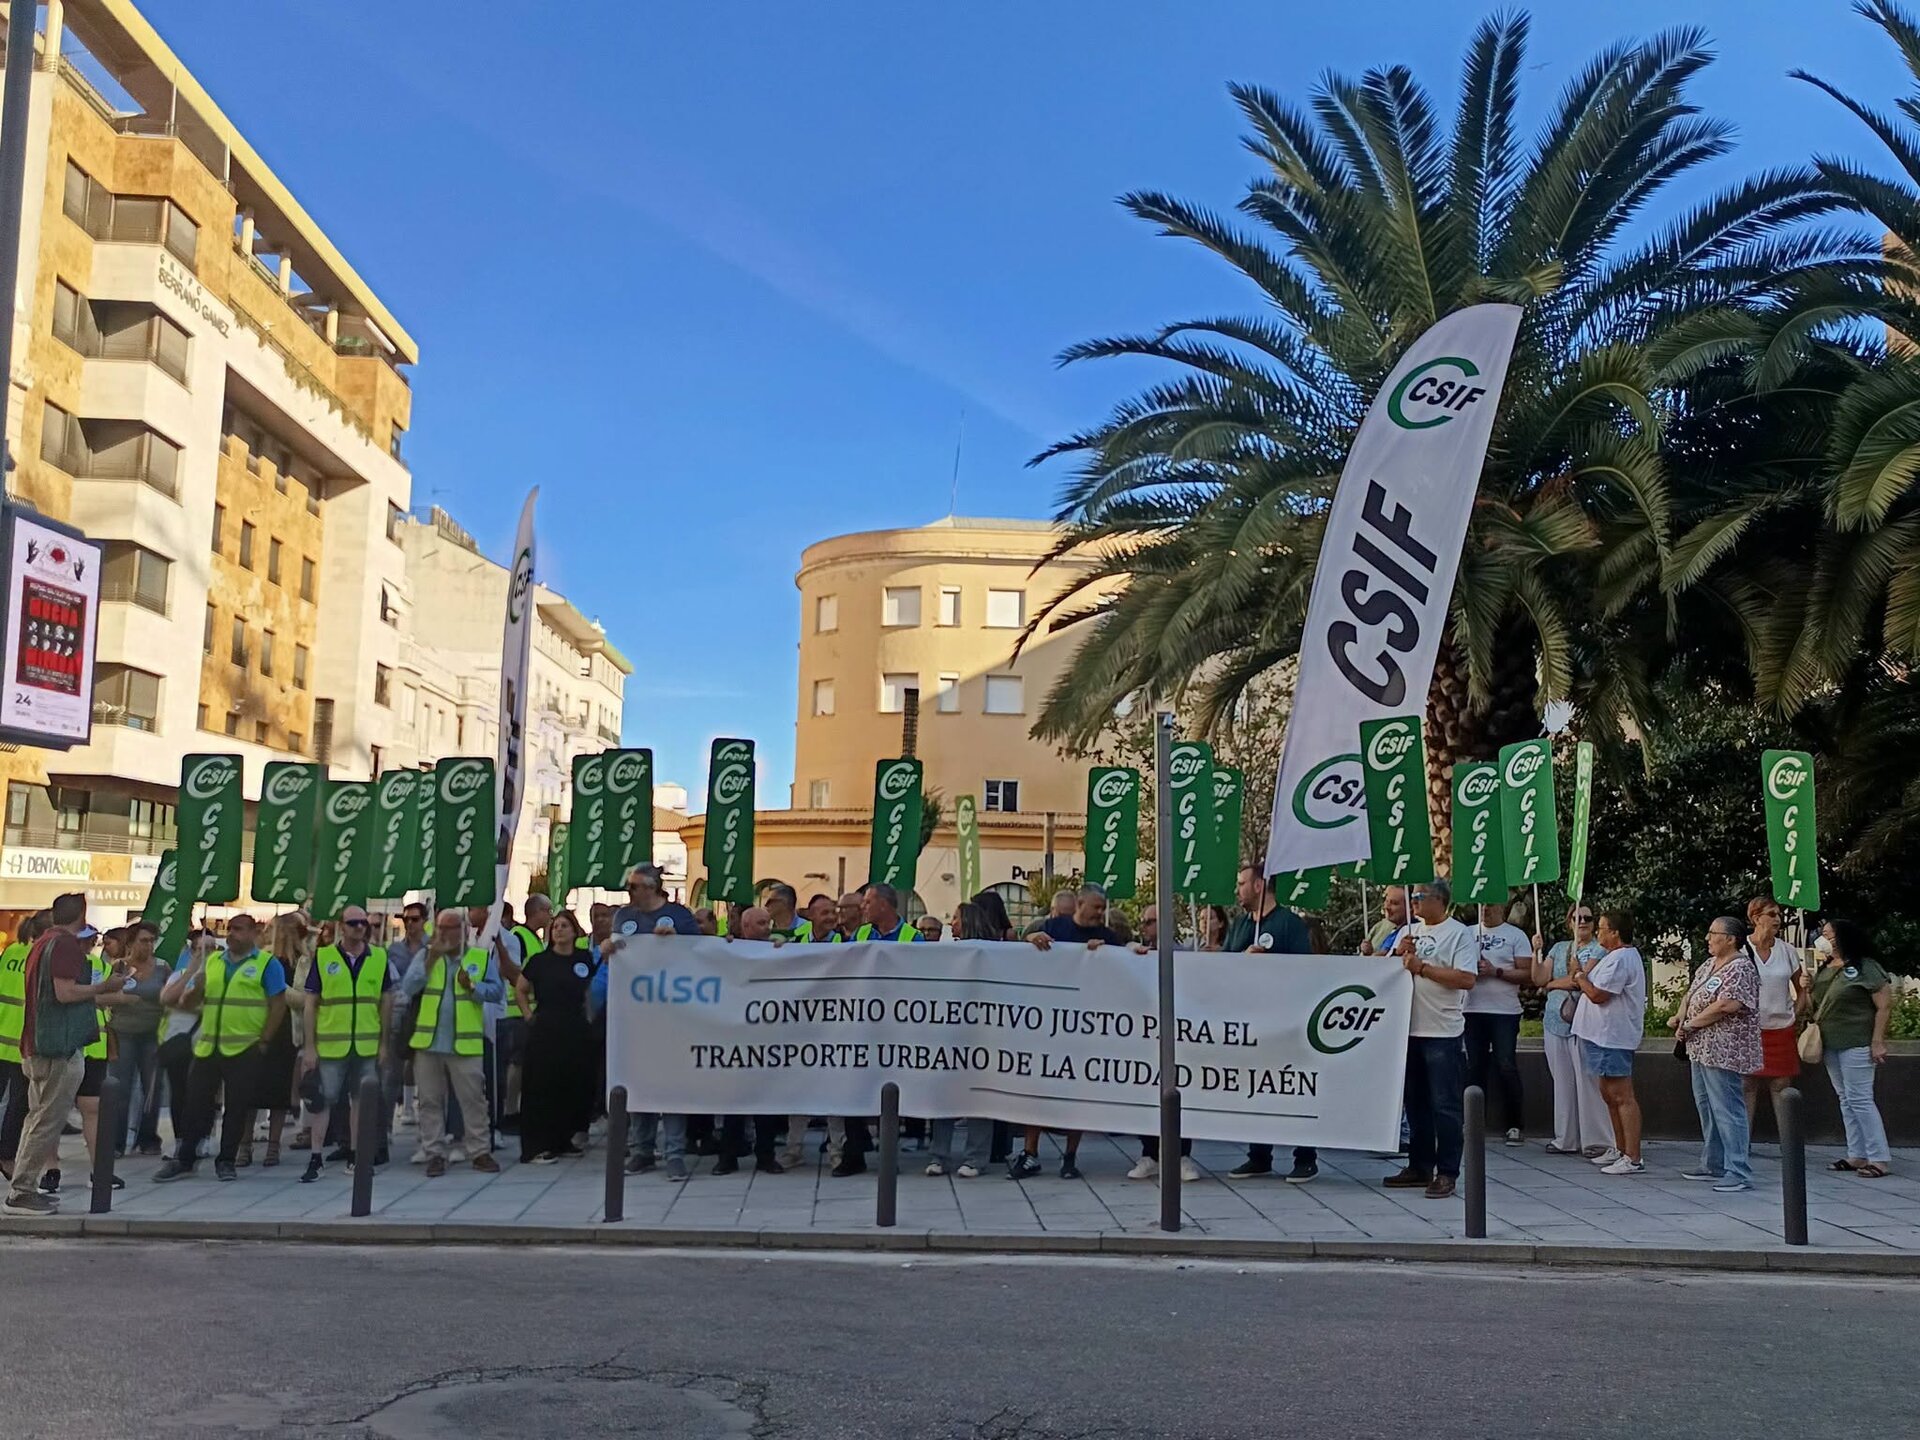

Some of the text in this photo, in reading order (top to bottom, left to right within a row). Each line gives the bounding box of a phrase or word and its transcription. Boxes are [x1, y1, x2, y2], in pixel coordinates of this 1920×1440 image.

[158, 268, 200, 313] SERRANO
[1408, 377, 1486, 411] CSIF
[1327, 479, 1438, 707] CSIF
[15, 692, 32, 706] 24
[1377, 734, 1415, 755] CSIF
[197, 767, 237, 785] CSIF
[616, 764, 648, 779] CSIF
[1171, 758, 1205, 774] CSIF
[1512, 753, 1545, 772] CSIF
[1775, 768, 1807, 786] CSIF
[276, 776, 312, 793] CSIF
[389, 782, 416, 797] CSIF
[451, 773, 489, 788] CSIF
[721, 776, 750, 791] CSIF
[887, 774, 917, 788] CSIF
[1102, 782, 1133, 795] CSIF
[1312, 774, 1368, 810] CSI
[1466, 778, 1501, 794] CSIF
[336, 795, 371, 810] CSIF
[884, 803, 905, 884] CSIF
[1178, 792, 1201, 888] CSIF
[1387, 774, 1411, 879] CSIF
[1520, 788, 1538, 879] CSIF
[28, 856, 90, 874] DENTASALUD
[197, 802, 222, 898] CSIF
[269, 810, 296, 899] CSIF
[380, 812, 403, 895] CSIF
[421, 810, 435, 886] CSIF
[455, 807, 476, 902] CSIF
[723, 808, 740, 897] CSIF
[1102, 811, 1121, 890] CSIF
[1470, 810, 1490, 899] CSIF
[1783, 805, 1802, 900] CSIF
[329, 828, 356, 916] CSIF
[630, 969, 722, 1004] alsa
[745, 998, 885, 1025] CONVENIO
[894, 999, 1043, 1030] COLECTIVO
[1050, 1007, 1133, 1037] JUSTO
[1223, 1022, 1258, 1047] EL
[1322, 1006, 1385, 1031] CSIF
[691, 1043, 869, 1069] TRANSPORTE
[877, 1044, 990, 1071] URBANO
[998, 1050, 1032, 1076] DE
[1041, 1055, 1076, 1080] LA
[1201, 1067, 1239, 1092] DE
[1246, 1064, 1318, 1098] JAÉN
